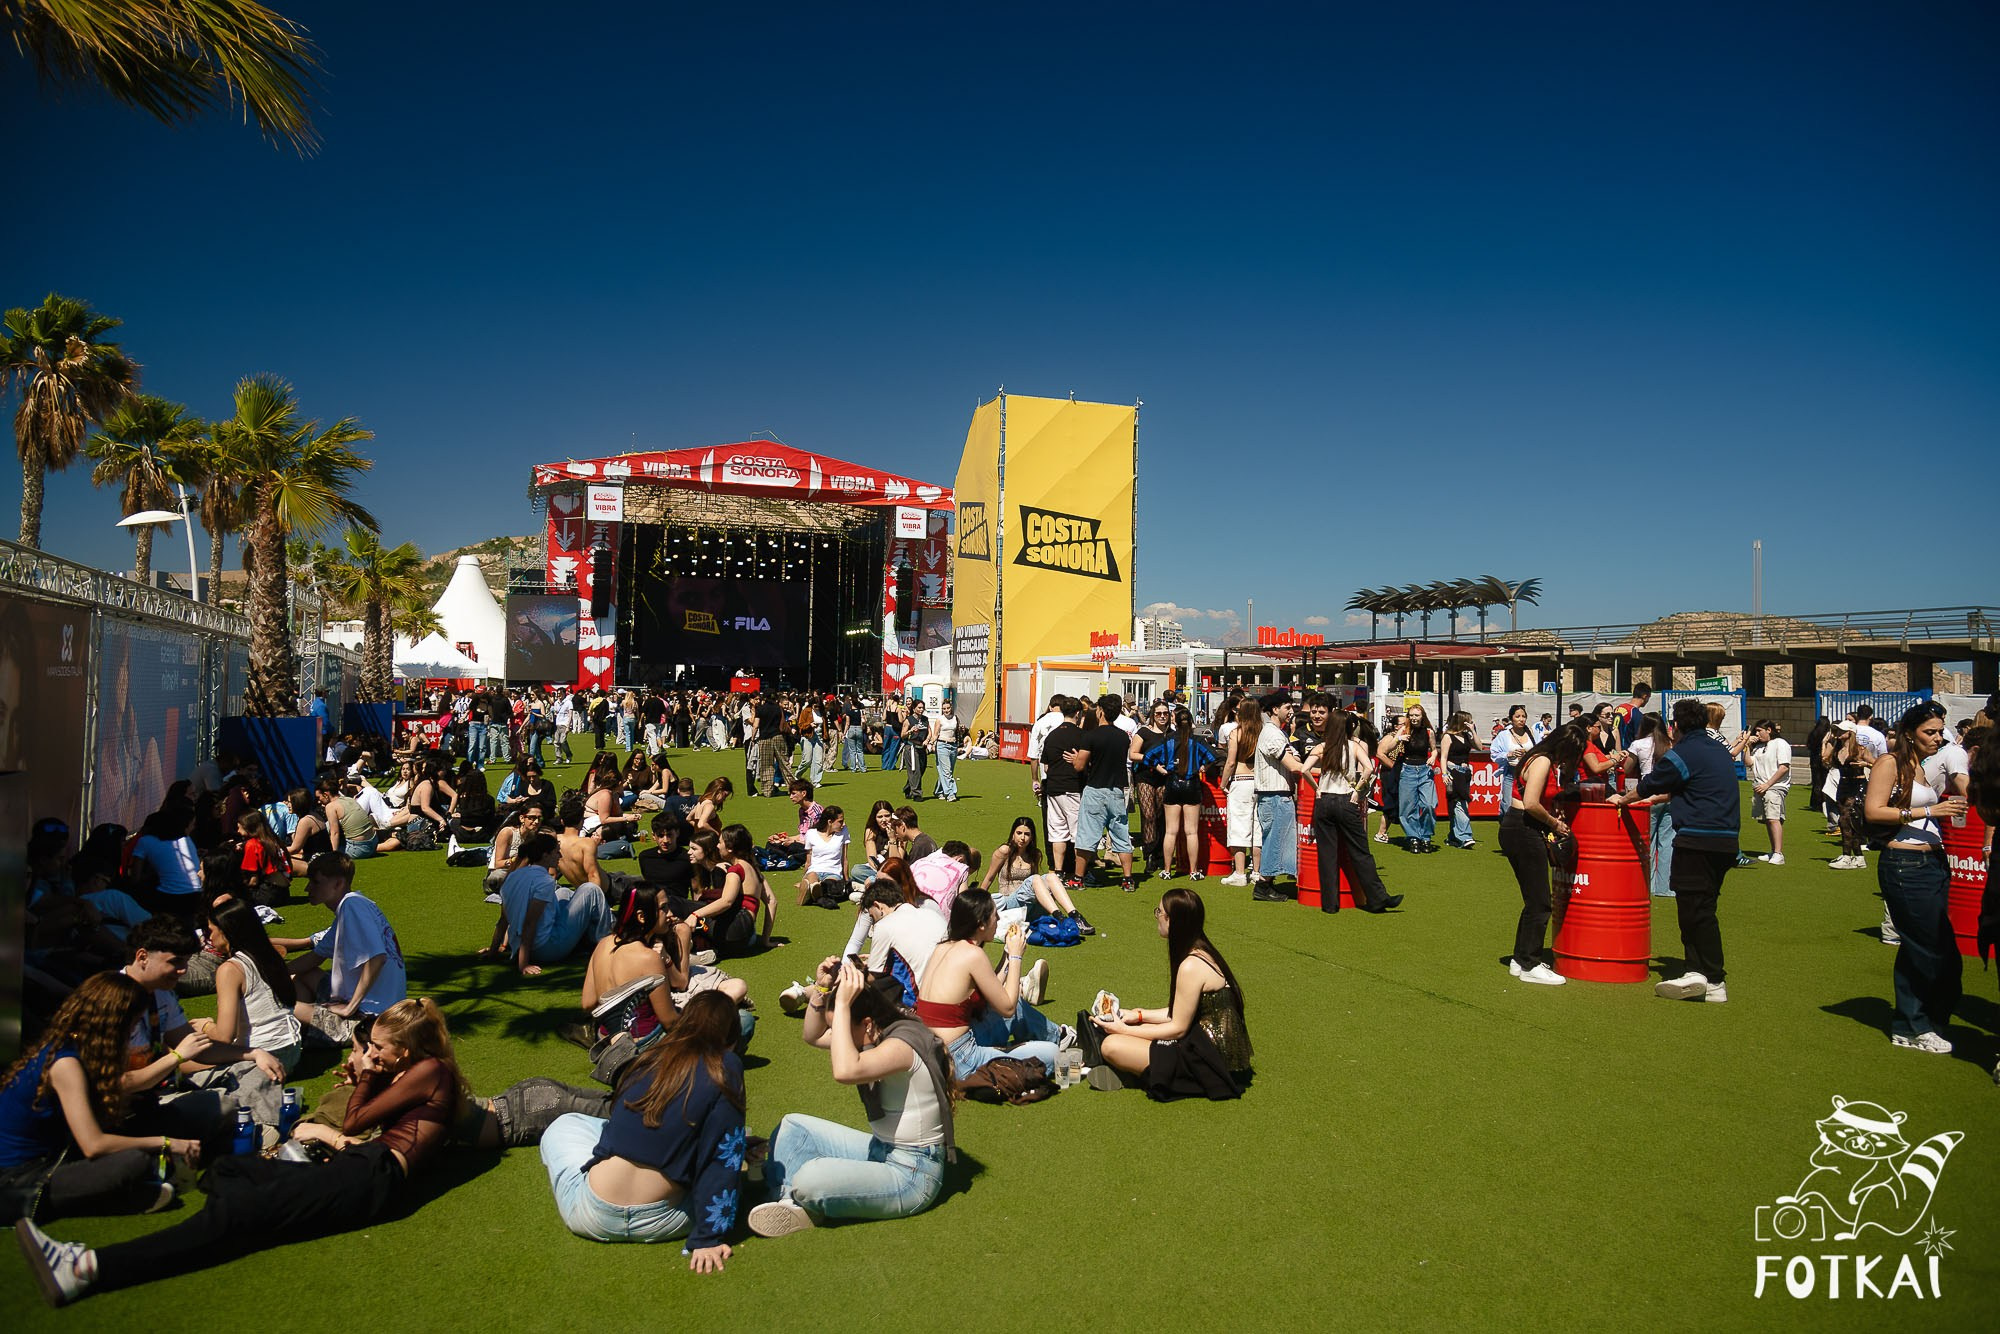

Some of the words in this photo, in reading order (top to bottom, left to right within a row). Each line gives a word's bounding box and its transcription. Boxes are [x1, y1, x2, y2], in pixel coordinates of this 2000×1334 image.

[731, 455, 786, 467] COSTA
[642, 461, 692, 479] VIBRA
[730, 465, 800, 480] SONORA
[830, 475, 876, 491] VIBRA
[902, 522, 922, 530] VIBRA
[961, 506, 983, 538] COSTA
[1026, 512, 1093, 545] COSTA
[960, 523, 988, 556] SONORA
[1025, 540, 1109, 575] SONORA
[735, 616, 771, 630] FILA
[955, 625, 964, 639] NO
[964, 623, 990, 638] VINIMOS
[1256, 625, 1325, 647] Mahou
[956, 640, 961, 653] A
[956, 652, 982, 666] VINIMOS
[982, 652, 988, 665] A
[959, 667, 985, 680] ROMPER
[957, 681, 964, 694] EL
